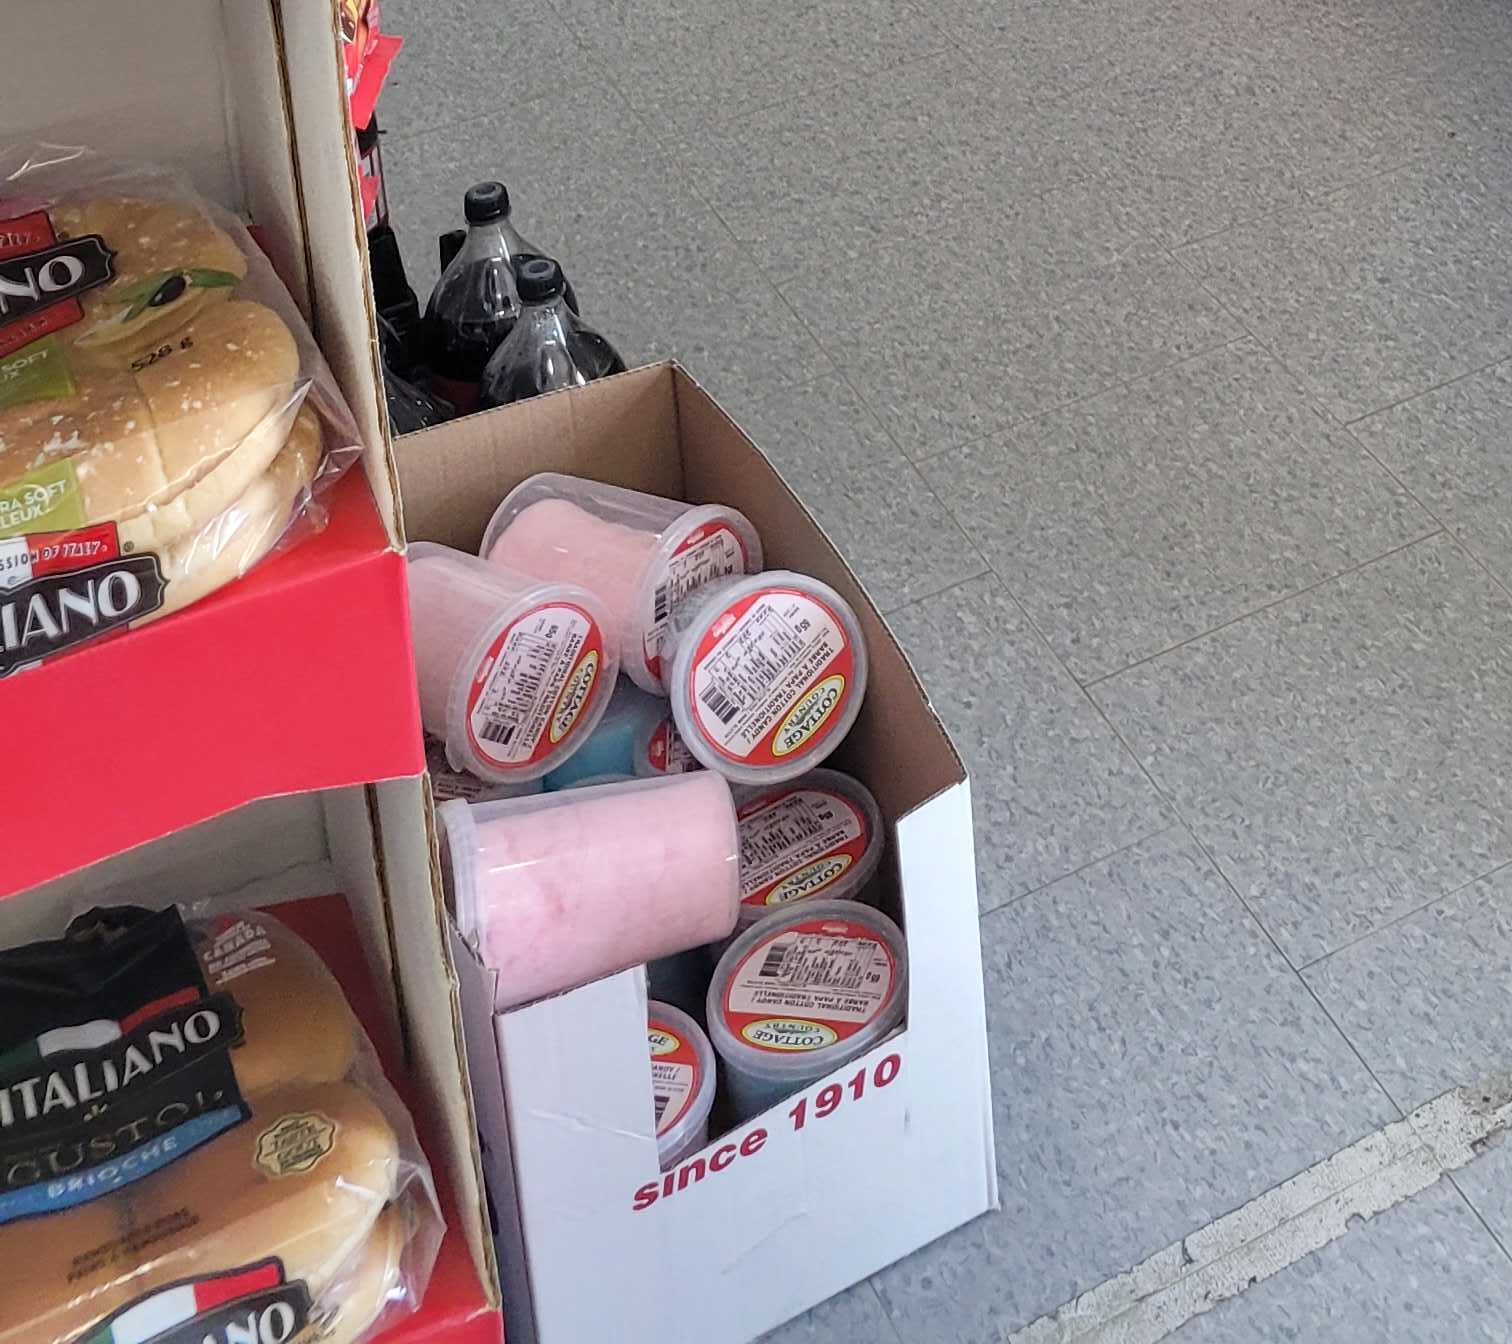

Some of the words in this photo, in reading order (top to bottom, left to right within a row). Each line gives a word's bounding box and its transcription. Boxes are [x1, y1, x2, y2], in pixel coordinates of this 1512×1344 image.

[2, 348, 49, 374] SOFT
[130, 341, 175, 373] 528
[24, 479, 67, 504] SOFT
[559, 662, 595, 732] COTTAGE
[784, 688, 837, 748] COTTAGE
[778, 861, 846, 903] COTTAGE
[751, 1029, 824, 1048] COTTAGE
[0, 1009, 222, 1128] ITALIANO
[631, 1128, 769, 1213] since
[787, 1051, 903, 1133] 1910
[46, 1138, 178, 1197] BRIOCHE
